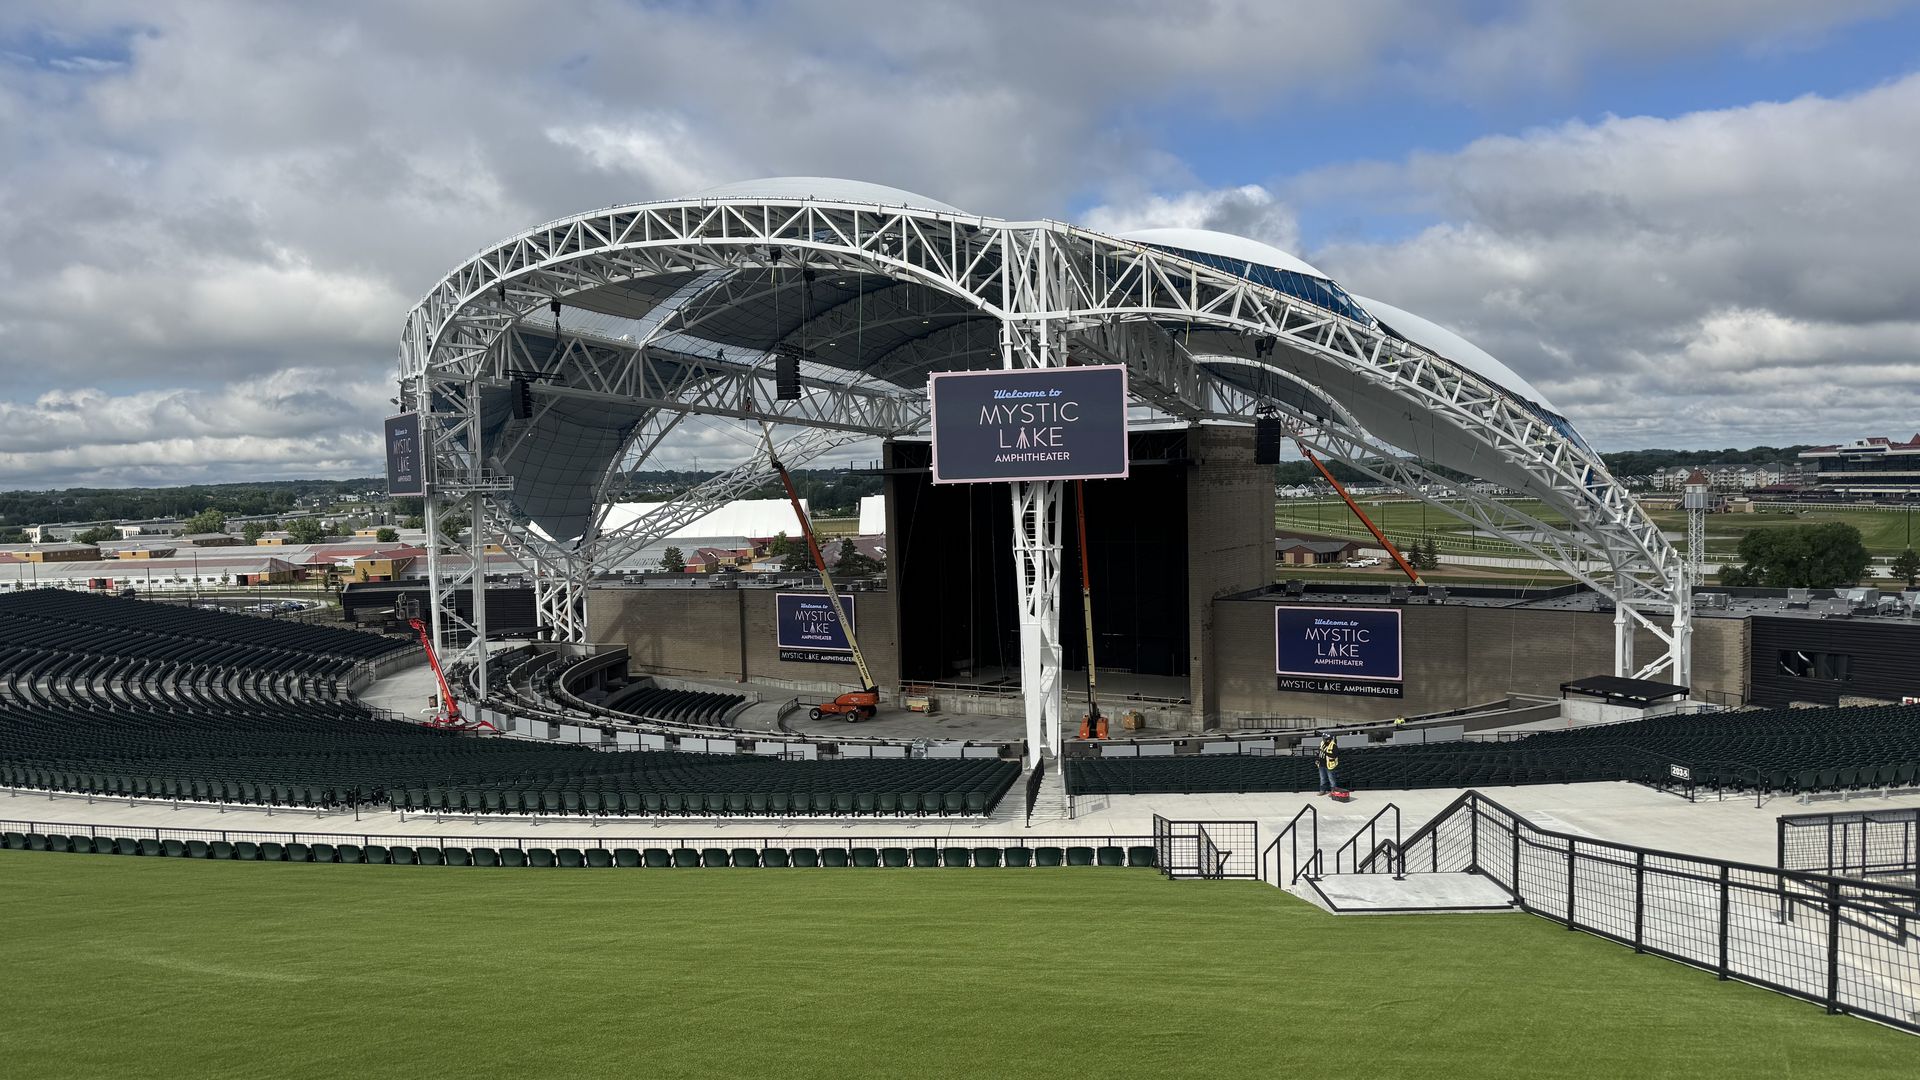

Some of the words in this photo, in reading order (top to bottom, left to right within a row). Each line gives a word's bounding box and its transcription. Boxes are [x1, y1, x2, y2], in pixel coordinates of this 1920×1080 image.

[993, 389, 1047, 399] Welcome
[1049, 388, 1063, 398] to
[979, 401, 1079, 425] MYSTIC
[1000, 426, 1064, 449] LAKE
[994, 452, 1070, 463] AMPHITHEATER
[795, 610, 836, 622] MYSTIC
[1314, 618, 1348, 626] Welcome
[803, 622, 829, 634] LAKE
[1305, 627, 1370, 643] MYSTIC
[1317, 642, 1360, 658] LAKE
[781, 652, 804, 660] MYSTIC
[804, 653, 820, 661] LAKE
[1314, 658, 1364, 667] AMPHITHEATER
[1280, 680, 1315, 690] MYSTIC
[1317, 682, 1341, 692] LAKE
[1343, 685, 1399, 695] AMPHITHEATER
